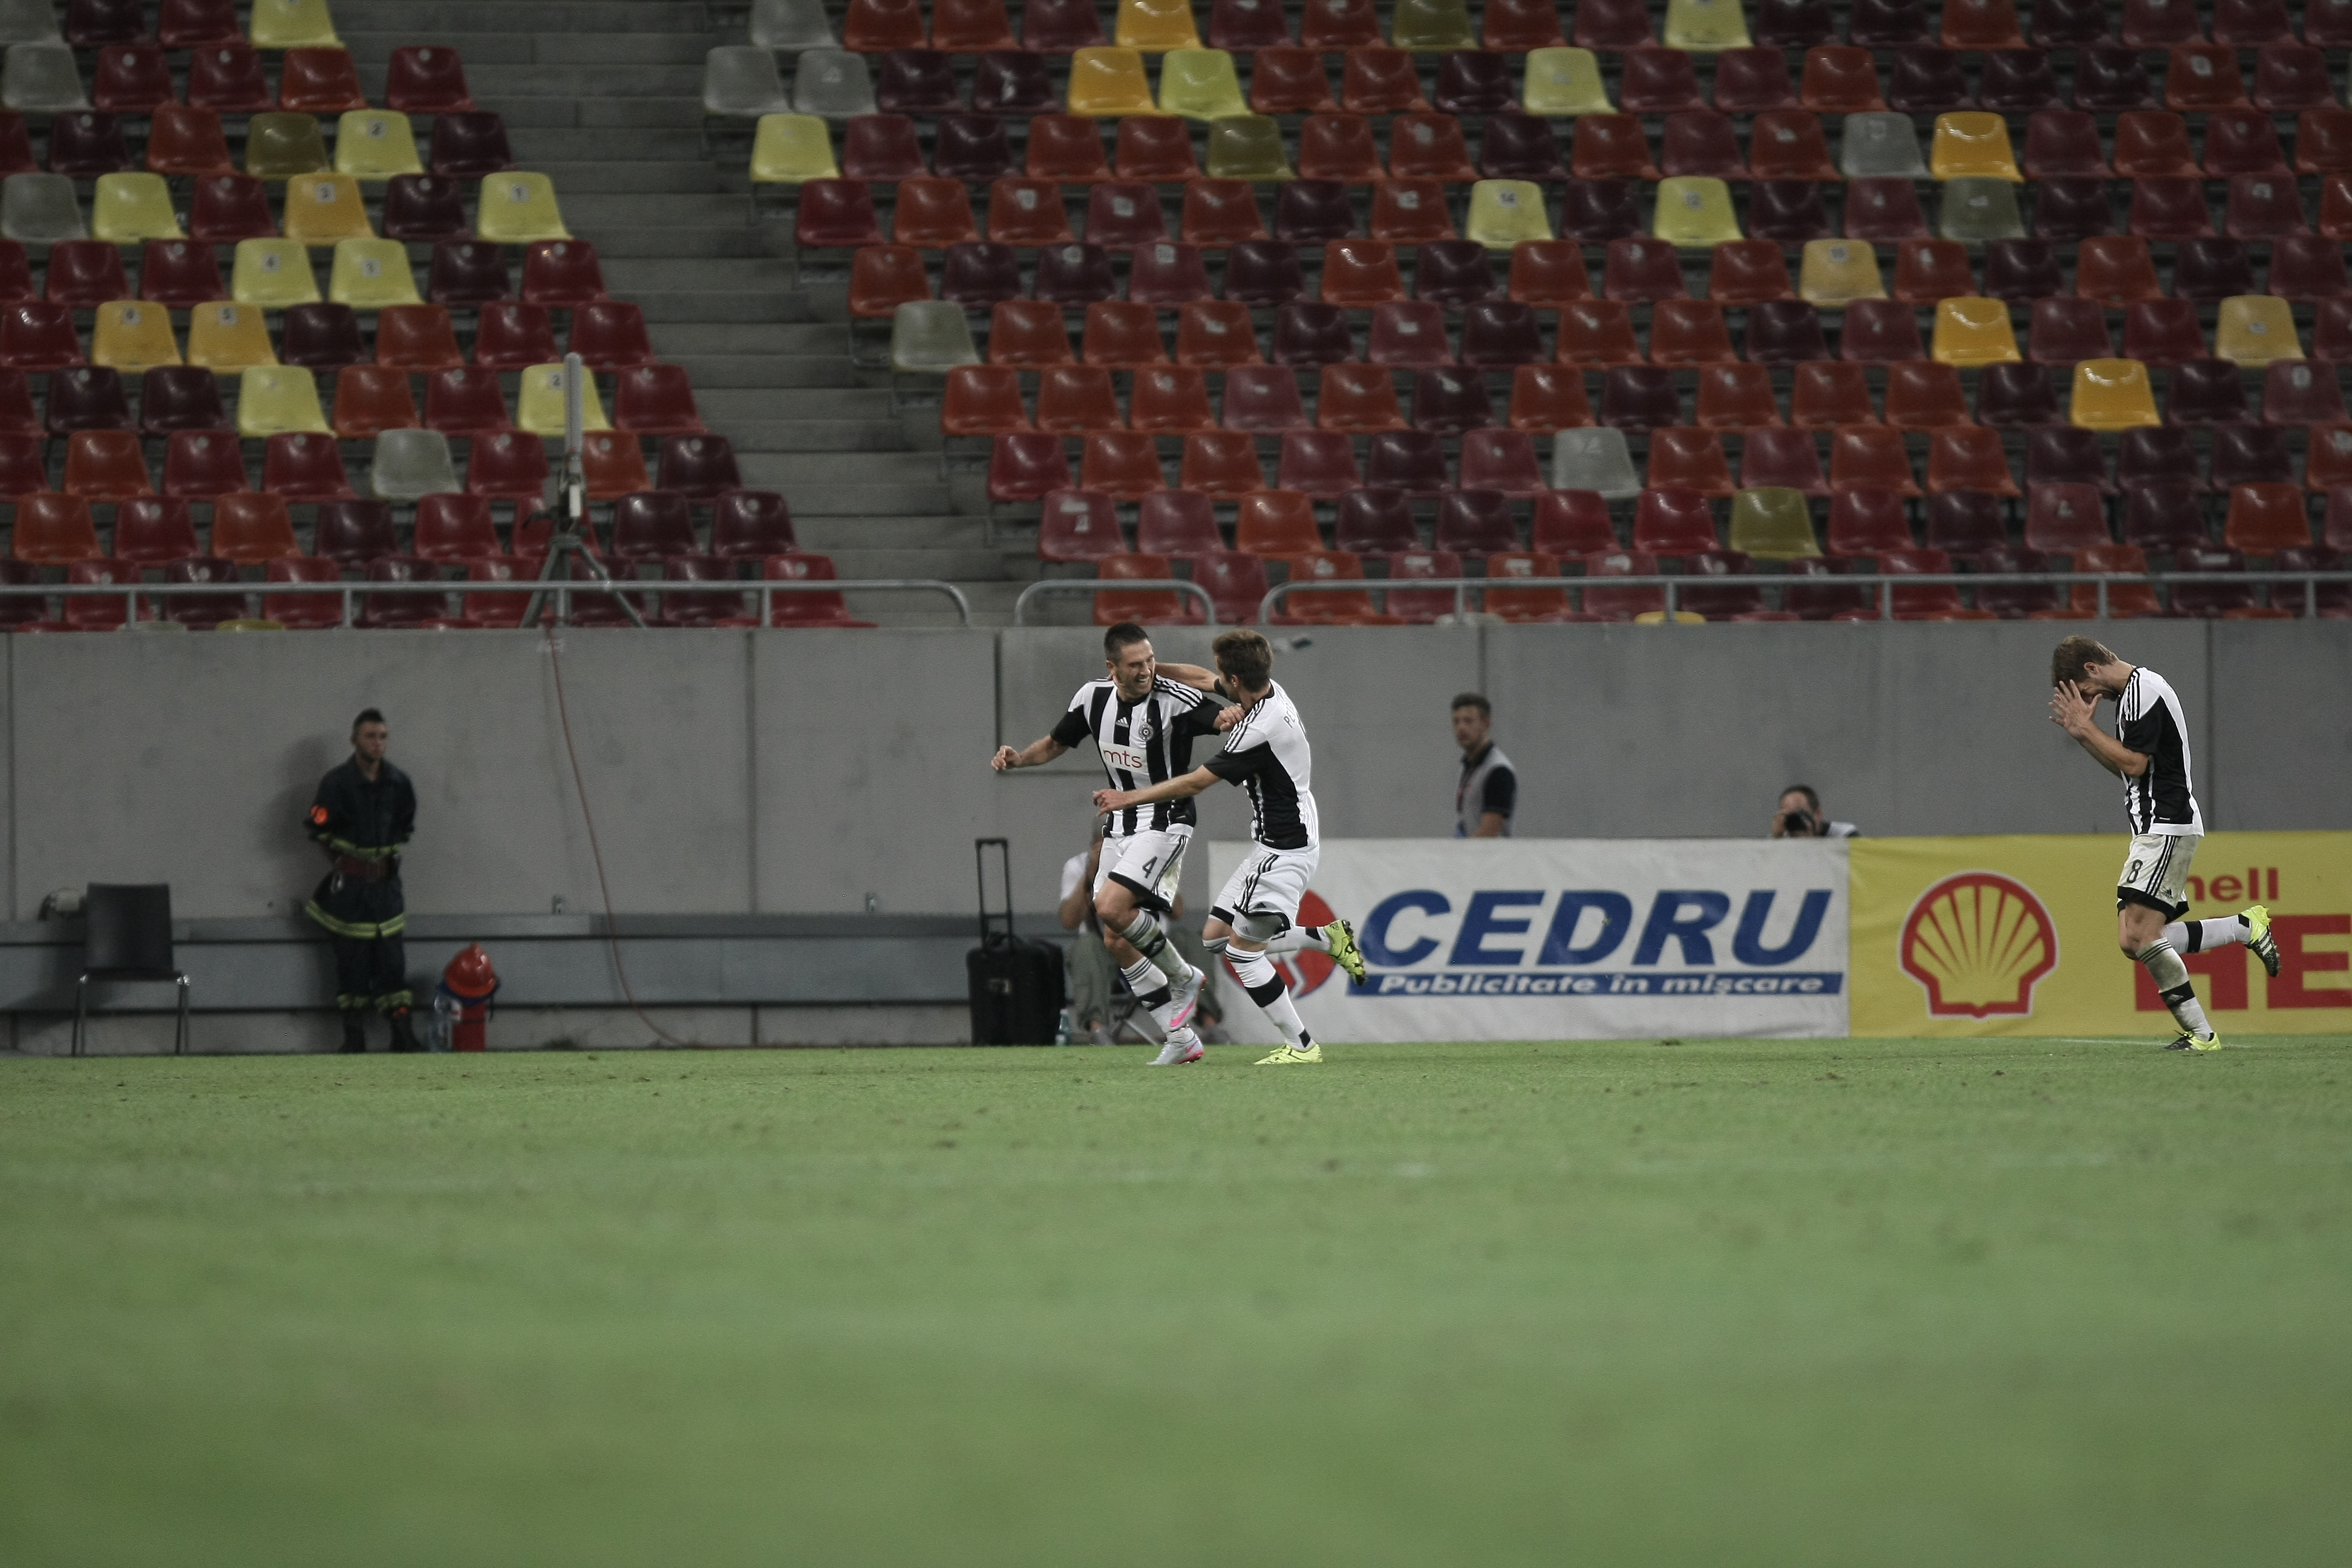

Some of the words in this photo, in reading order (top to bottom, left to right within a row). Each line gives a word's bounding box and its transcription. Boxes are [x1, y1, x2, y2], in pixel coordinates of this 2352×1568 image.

[1102, 750, 1143, 768] mts
[1142, 855, 1158, 879] 4
[2126, 859, 2143, 884] 8
[1359, 889, 1832, 968] CEDRU
[1378, 975, 1598, 994] Publicitate
